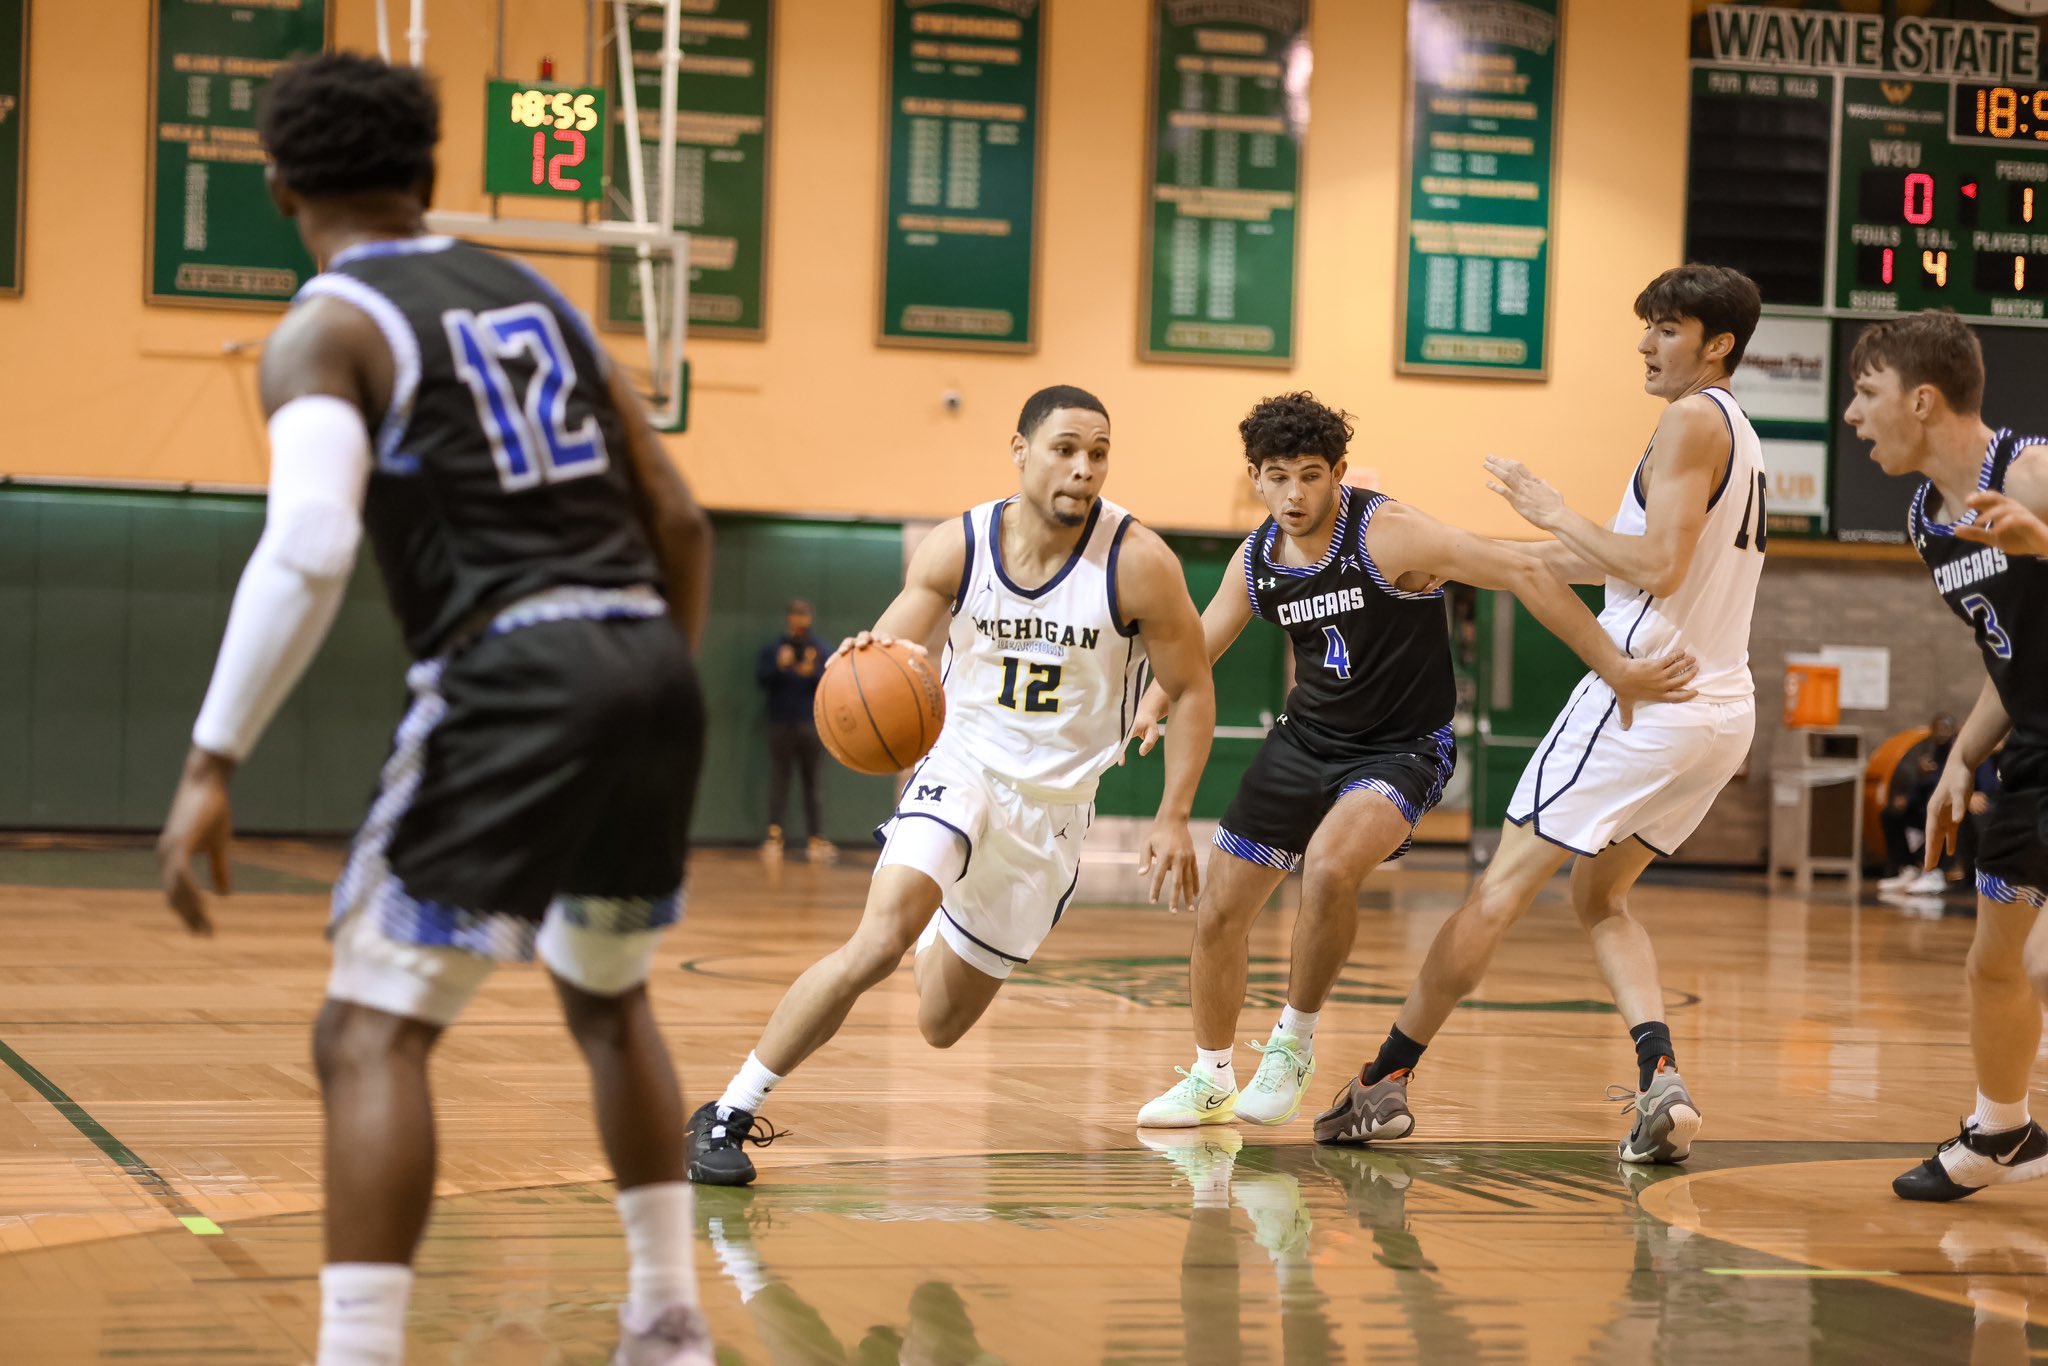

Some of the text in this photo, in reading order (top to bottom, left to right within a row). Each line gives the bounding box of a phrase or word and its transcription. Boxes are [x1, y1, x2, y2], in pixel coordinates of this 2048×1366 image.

[1708, 4, 2040, 82] WAYNE STATE
[511, 90, 598, 131] 18:55
[532, 129, 586, 191] 12
[1869, 138, 1922, 168] WSU
[1904, 173, 1934, 225] 0
[2022, 187, 2034, 223] 1
[1851, 224, 1901, 247] FOULS
[1972, 231, 2029, 253] PLAYER
[1882, 248, 1894, 285] 1
[1922, 250, 1948, 288] 4
[2014, 255, 2026, 292] 1
[441, 301, 610, 493] 12
[1934, 546, 2009, 595] COUGARS
[1277, 587, 1365, 626] COUGARS
[972, 616, 1100, 650] MICHIGAN
[1961, 593, 2012, 659] 3
[997, 639, 1065, 657] DEARBORN
[1322, 625, 1351, 679] 4
[997, 656, 1062, 715] 12
[914, 784, 947, 802] M
